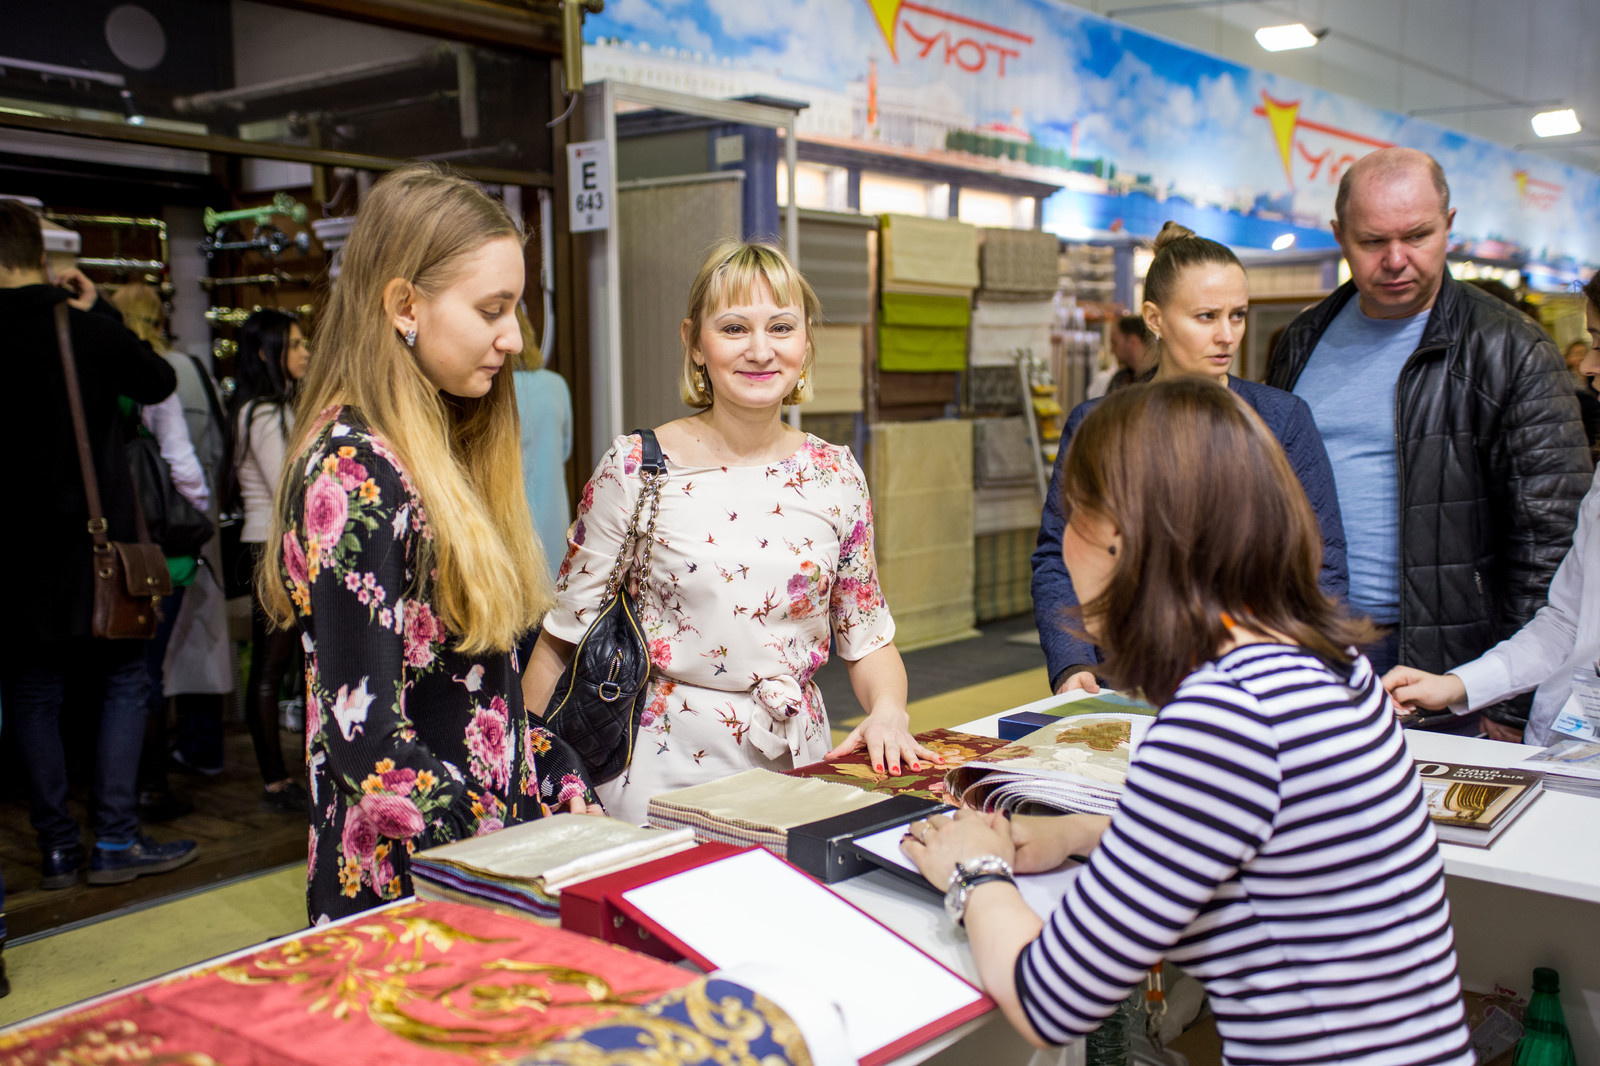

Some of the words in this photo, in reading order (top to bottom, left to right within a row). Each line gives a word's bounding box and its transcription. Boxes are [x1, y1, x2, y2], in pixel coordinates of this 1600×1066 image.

[582, 161, 597, 190] E
[1297, 140, 1357, 185] УЮ
[576, 192, 604, 212] 643
